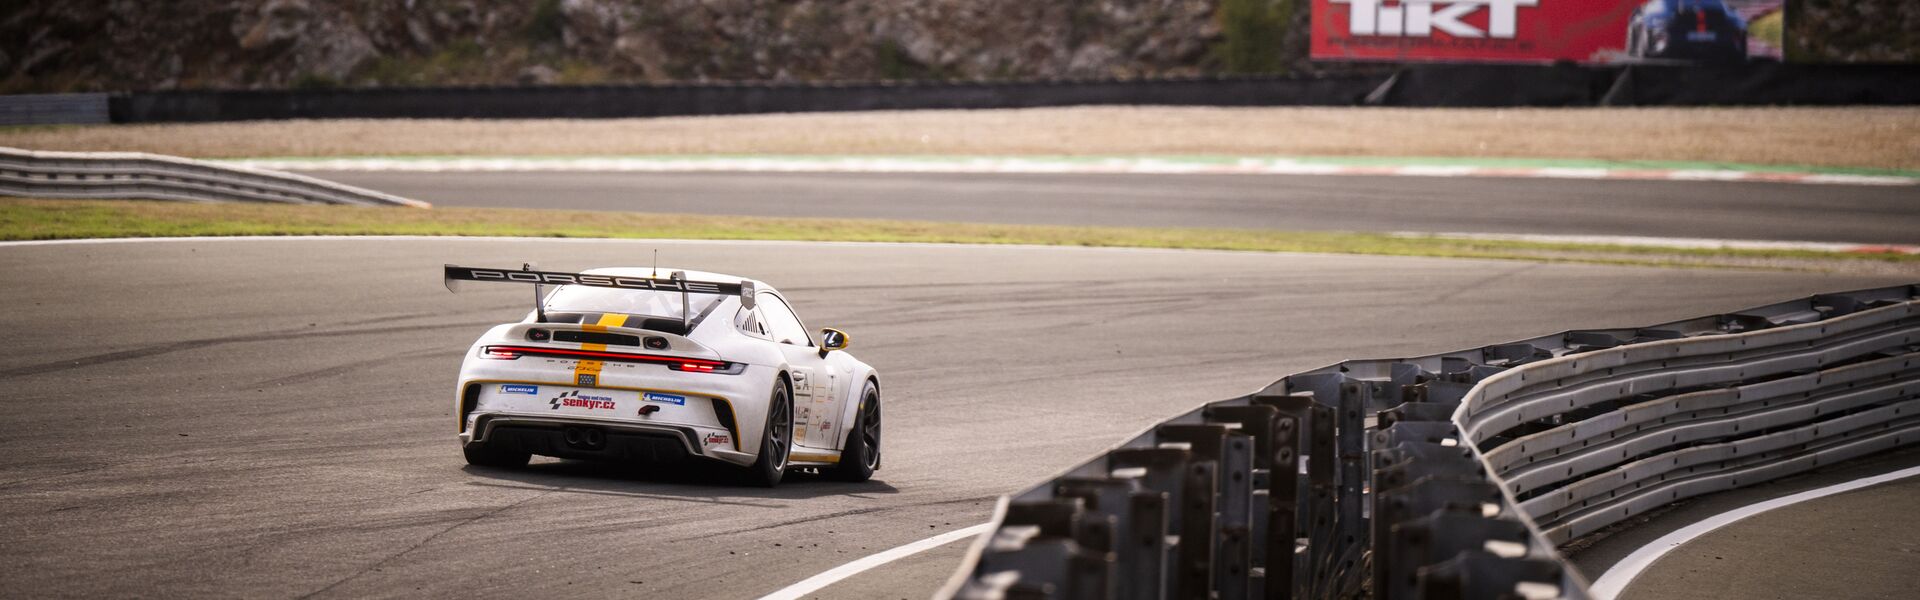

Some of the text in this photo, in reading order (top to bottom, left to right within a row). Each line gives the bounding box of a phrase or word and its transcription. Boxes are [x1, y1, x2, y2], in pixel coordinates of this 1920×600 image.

[471, 270, 721, 293] PORSCHE
[562, 398, 616, 410] senkyr.cz
[652, 395, 682, 403] MICHELIN
